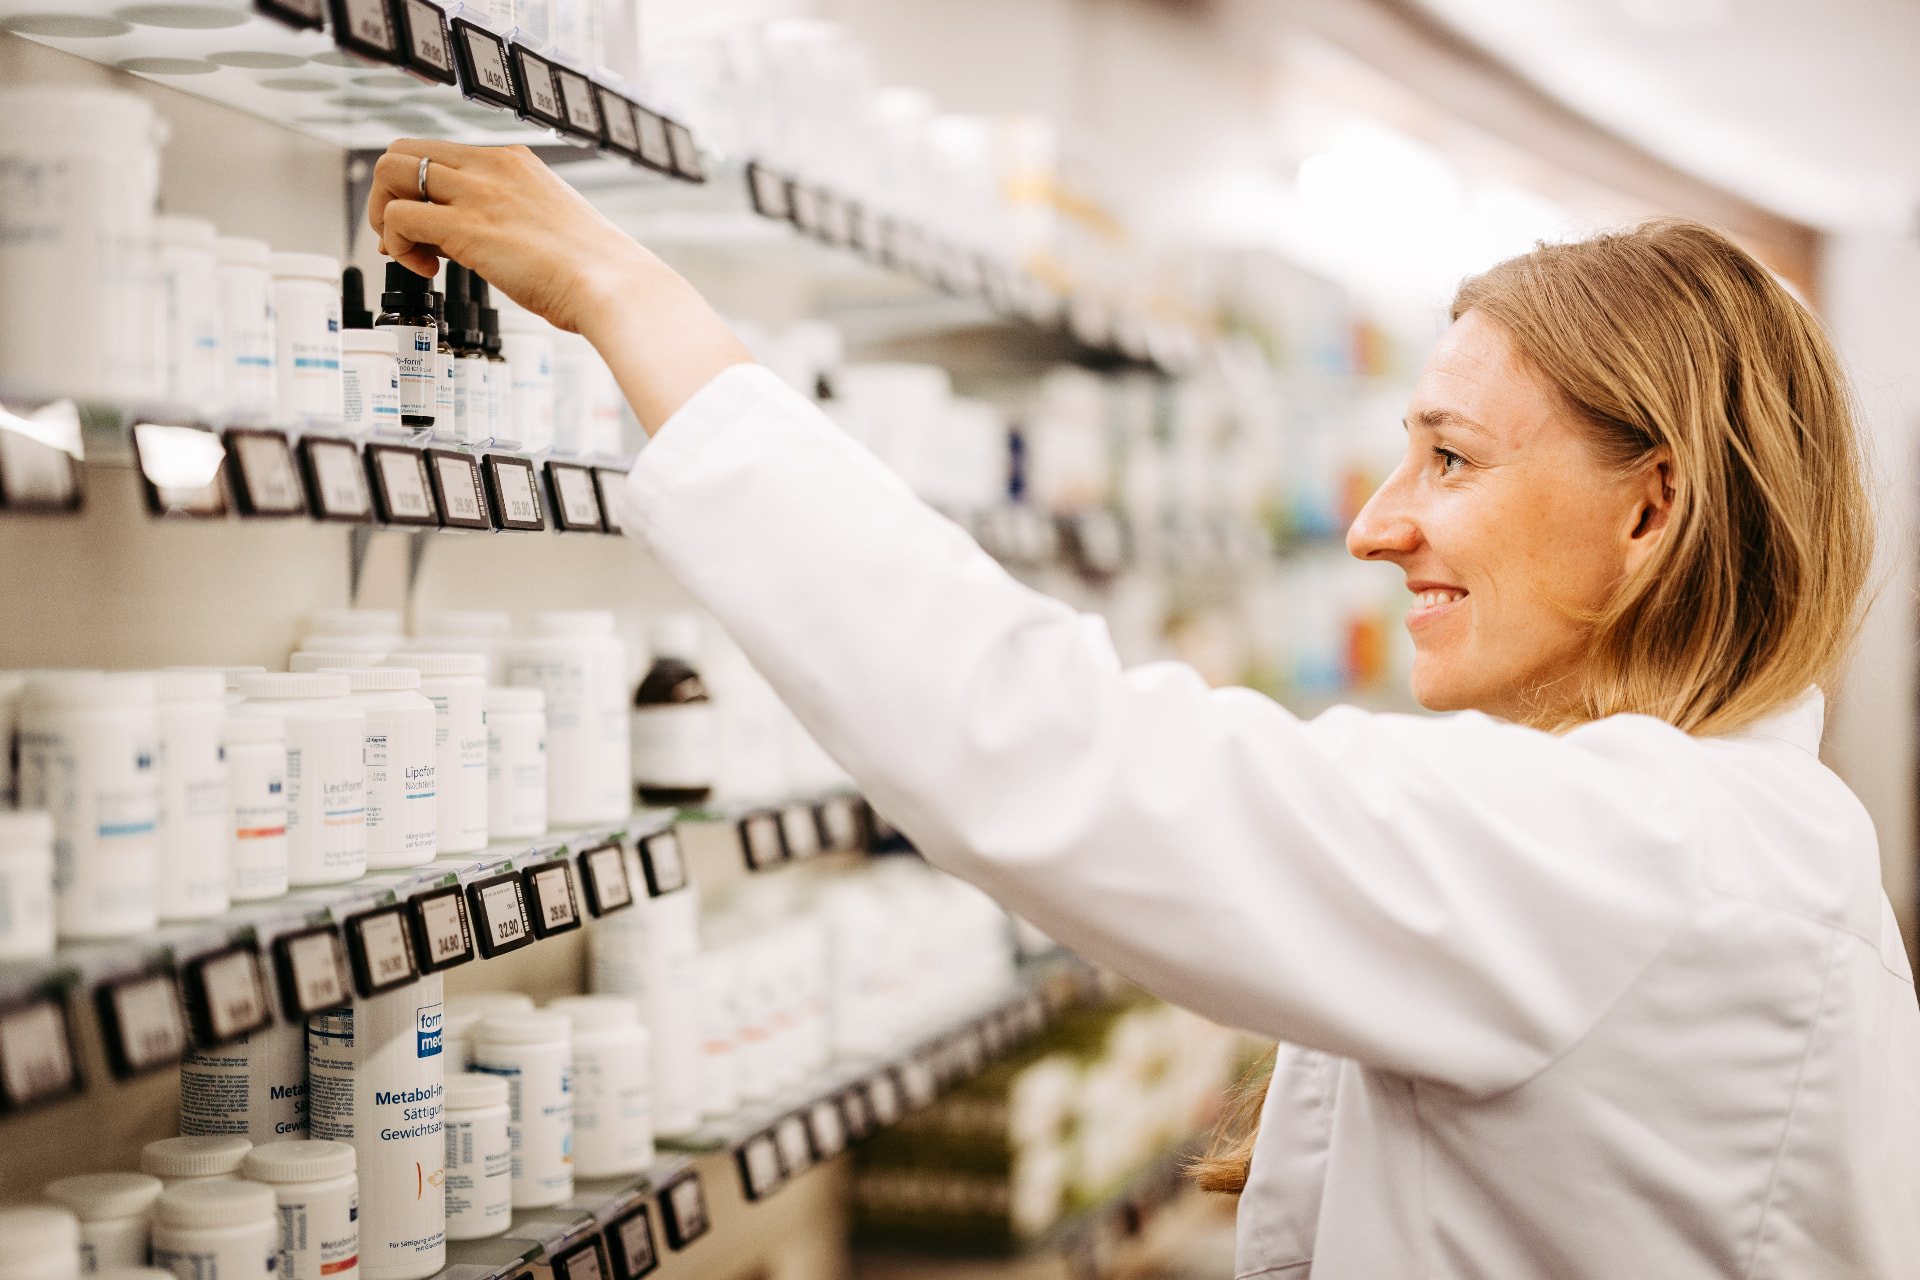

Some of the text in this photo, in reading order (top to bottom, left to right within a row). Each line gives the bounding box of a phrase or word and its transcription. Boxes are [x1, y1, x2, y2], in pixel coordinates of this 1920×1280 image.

[483, 67, 504, 90] 14.90
[498, 918, 519, 939] 32.90
[375, 1082, 443, 1106] Metabol-in
